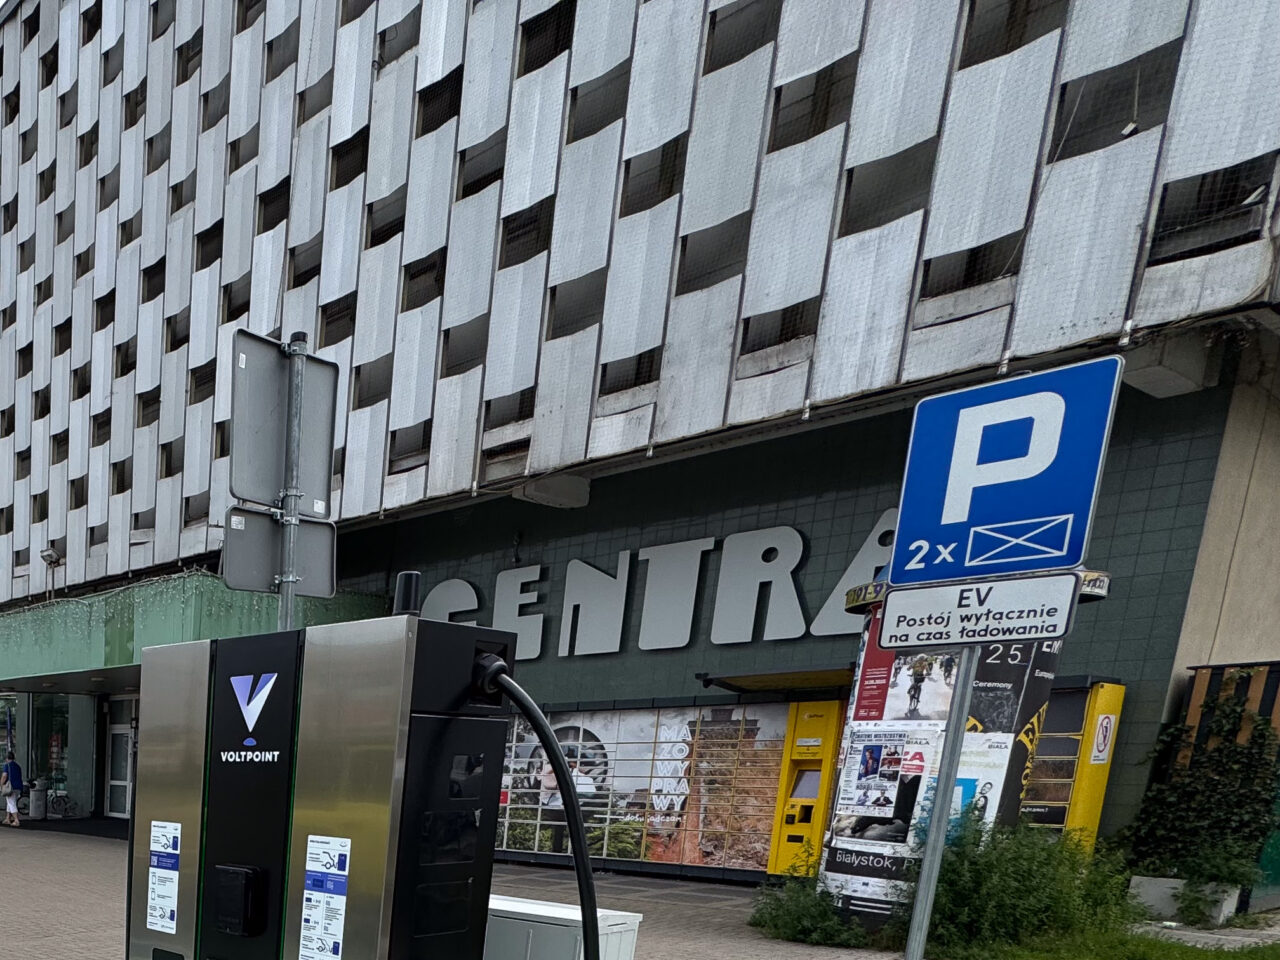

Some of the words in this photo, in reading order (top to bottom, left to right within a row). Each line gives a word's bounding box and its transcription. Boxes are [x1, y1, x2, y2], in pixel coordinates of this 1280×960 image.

[940, 391, 1066, 525] P
[420, 508, 897, 661] CENTRA
[956, 586, 994, 608] EV
[896, 612, 952, 628] Postój
[959, 606, 1058, 630] wyłącznie
[888, 631, 909, 643] na
[916, 628, 951, 641] czas
[958, 622, 1058, 640] ładowania
[972, 680, 1013, 690] Ceremony
[221, 751, 280, 762] VOLTPOINT
[655, 761, 690, 776] WY
[650, 778, 690, 794] PRA
[652, 795, 686, 811] WY
[835, 850, 897, 871] Białystok,
